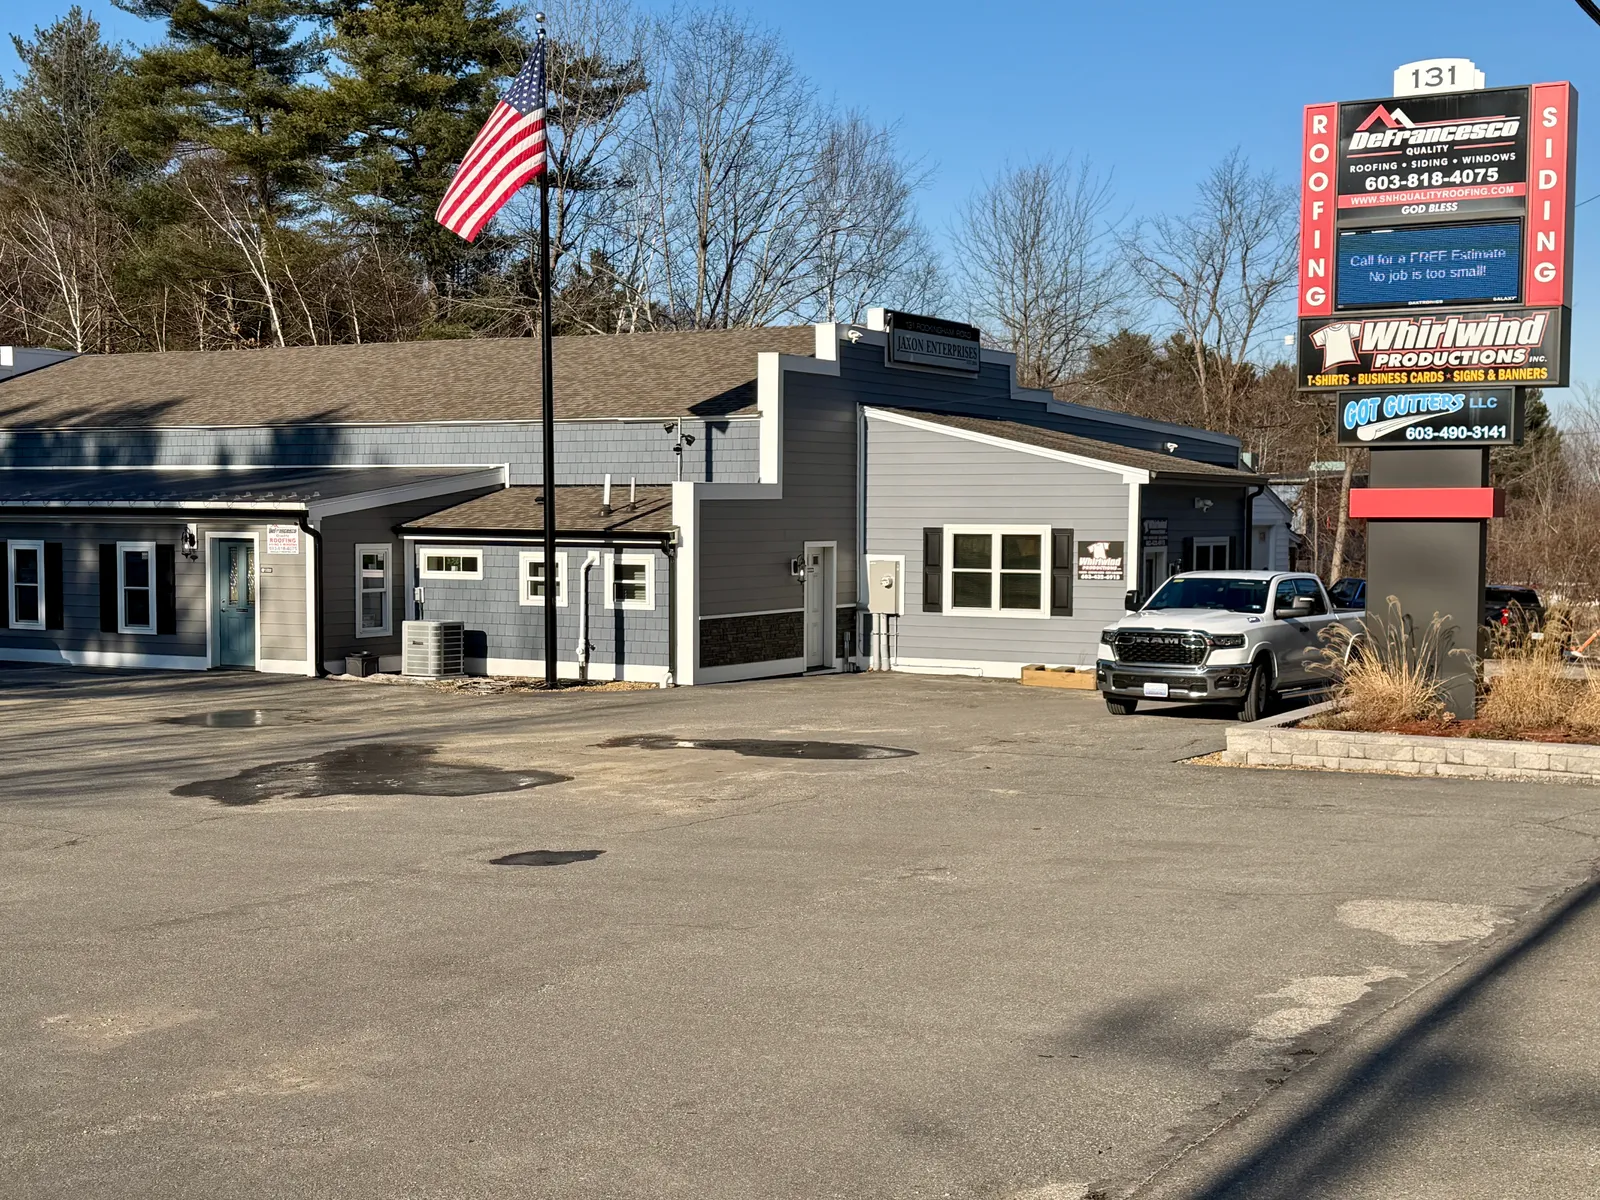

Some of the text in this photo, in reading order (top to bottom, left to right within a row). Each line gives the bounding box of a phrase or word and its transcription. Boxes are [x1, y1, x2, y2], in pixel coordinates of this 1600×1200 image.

[1411, 65, 1457, 89] 131
[1348, 120, 1521, 151] DeFrancesco
[1405, 144, 1450, 156] QUALITY
[1349, 152, 1517, 173] ROOFING SIDING WINDOWS
[1364, 167, 1499, 192] 603-818-4075
[1350, 185, 1515, 205] WWW.SNHQUALITYROOFING.COM
[1534, 106, 1558, 283] SIDING
[1305, 114, 1330, 307] ROOFING
[1401, 202, 1458, 216] GOD BLESS
[1350, 247, 1507, 268] Call for a FREE Estimate
[1369, 265, 1487, 284] No job is too small!
[1361, 315, 1546, 351] Whirlwind
[896, 335, 978, 360] JAXON ENTERPRISES
[1374, 348, 1548, 368] PRODUCTIONS INC.
[1307, 367, 1548, 386] T-SHIRTS BUSINESS CARDS SIGNS & BANNERS
[1343, 392, 1498, 430] GOT GUTTERS LLC
[1405, 425, 1507, 441] 603-490-3141
[1136, 636, 1179, 644] RAM
